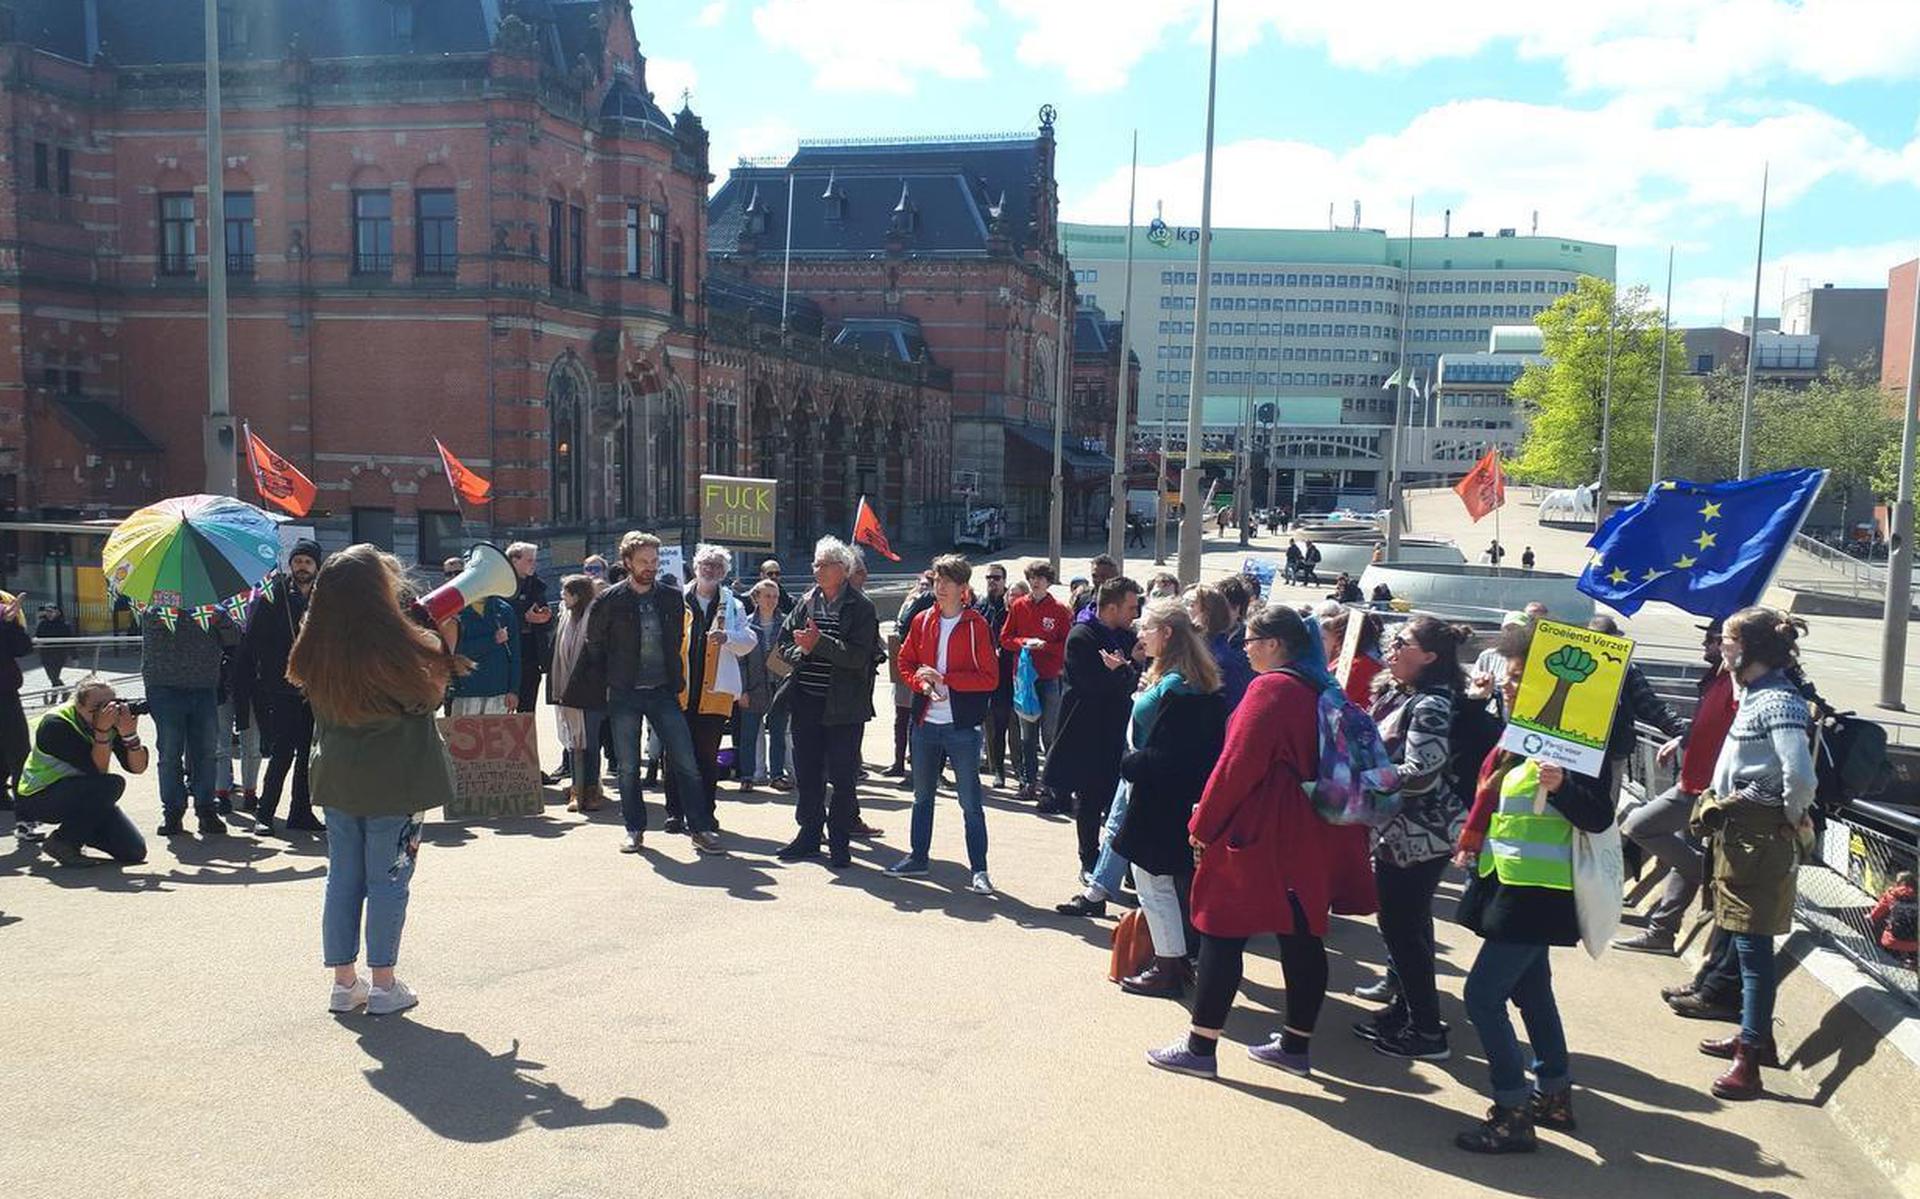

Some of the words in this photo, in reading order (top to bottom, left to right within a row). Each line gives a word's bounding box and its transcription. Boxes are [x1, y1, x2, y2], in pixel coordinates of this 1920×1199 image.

[1177, 227, 1213, 245] kp
[706, 484, 771, 513] FUCK
[714, 513, 764, 538] SHELL
[1538, 622, 1591, 644] Groeiend
[1593, 635, 1630, 654] Verzet
[450, 716, 539, 763] SEX
